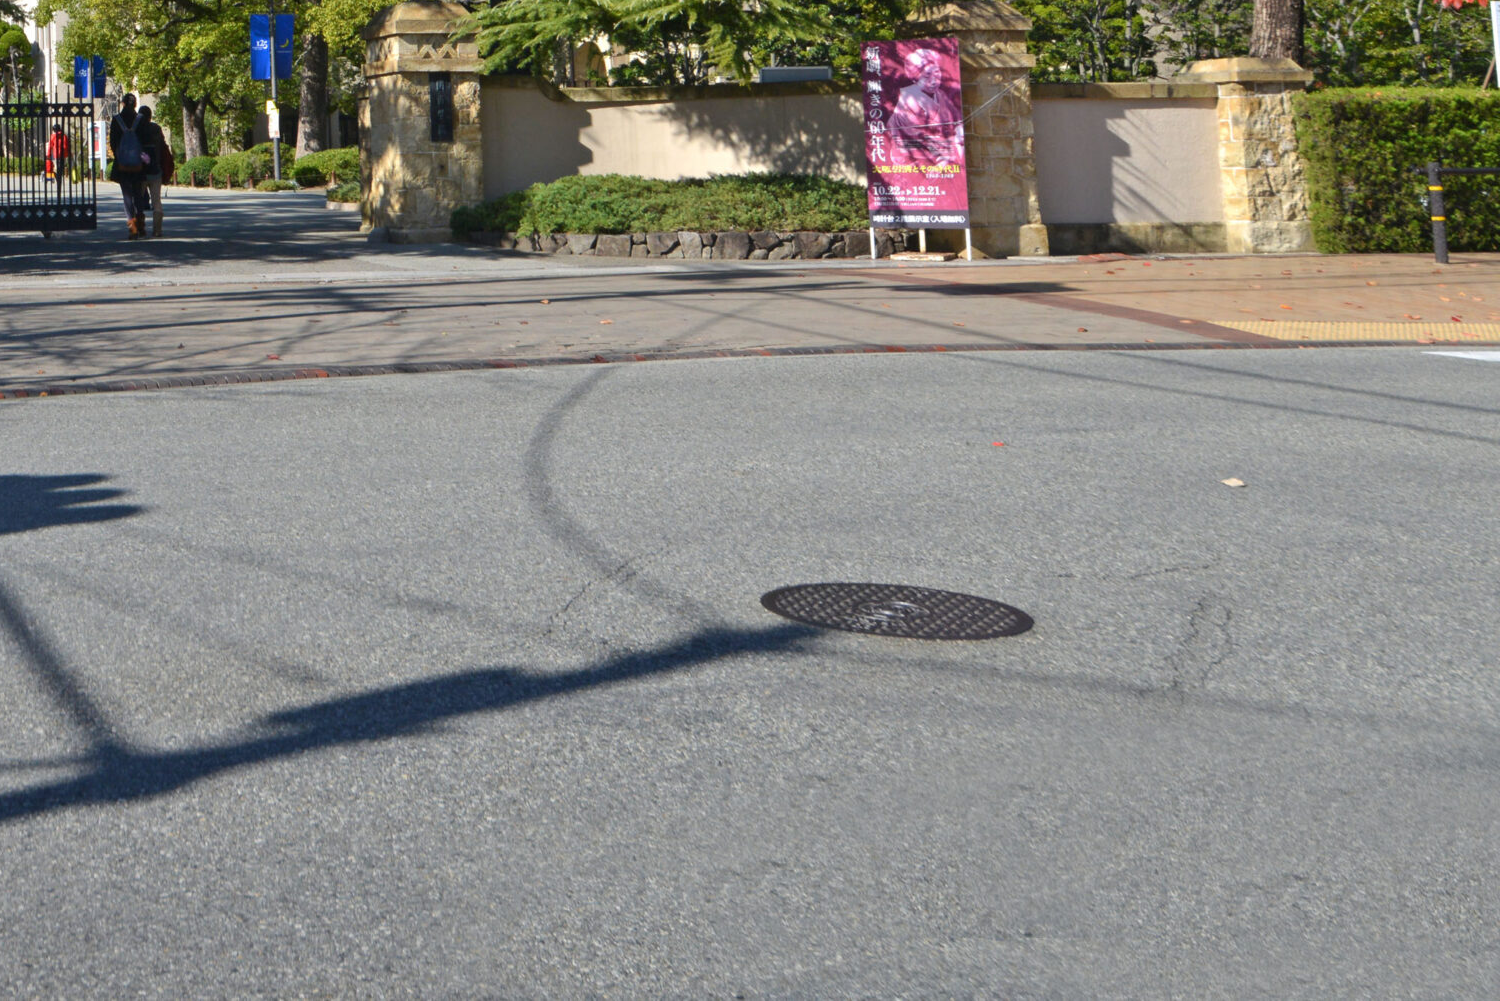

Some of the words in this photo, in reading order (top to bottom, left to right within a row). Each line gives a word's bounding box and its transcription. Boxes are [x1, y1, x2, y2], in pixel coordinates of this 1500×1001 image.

[256, 39, 268, 50] 125
[873, 185, 901, 196] 10.22
[912, 185, 941, 196] 12.21
